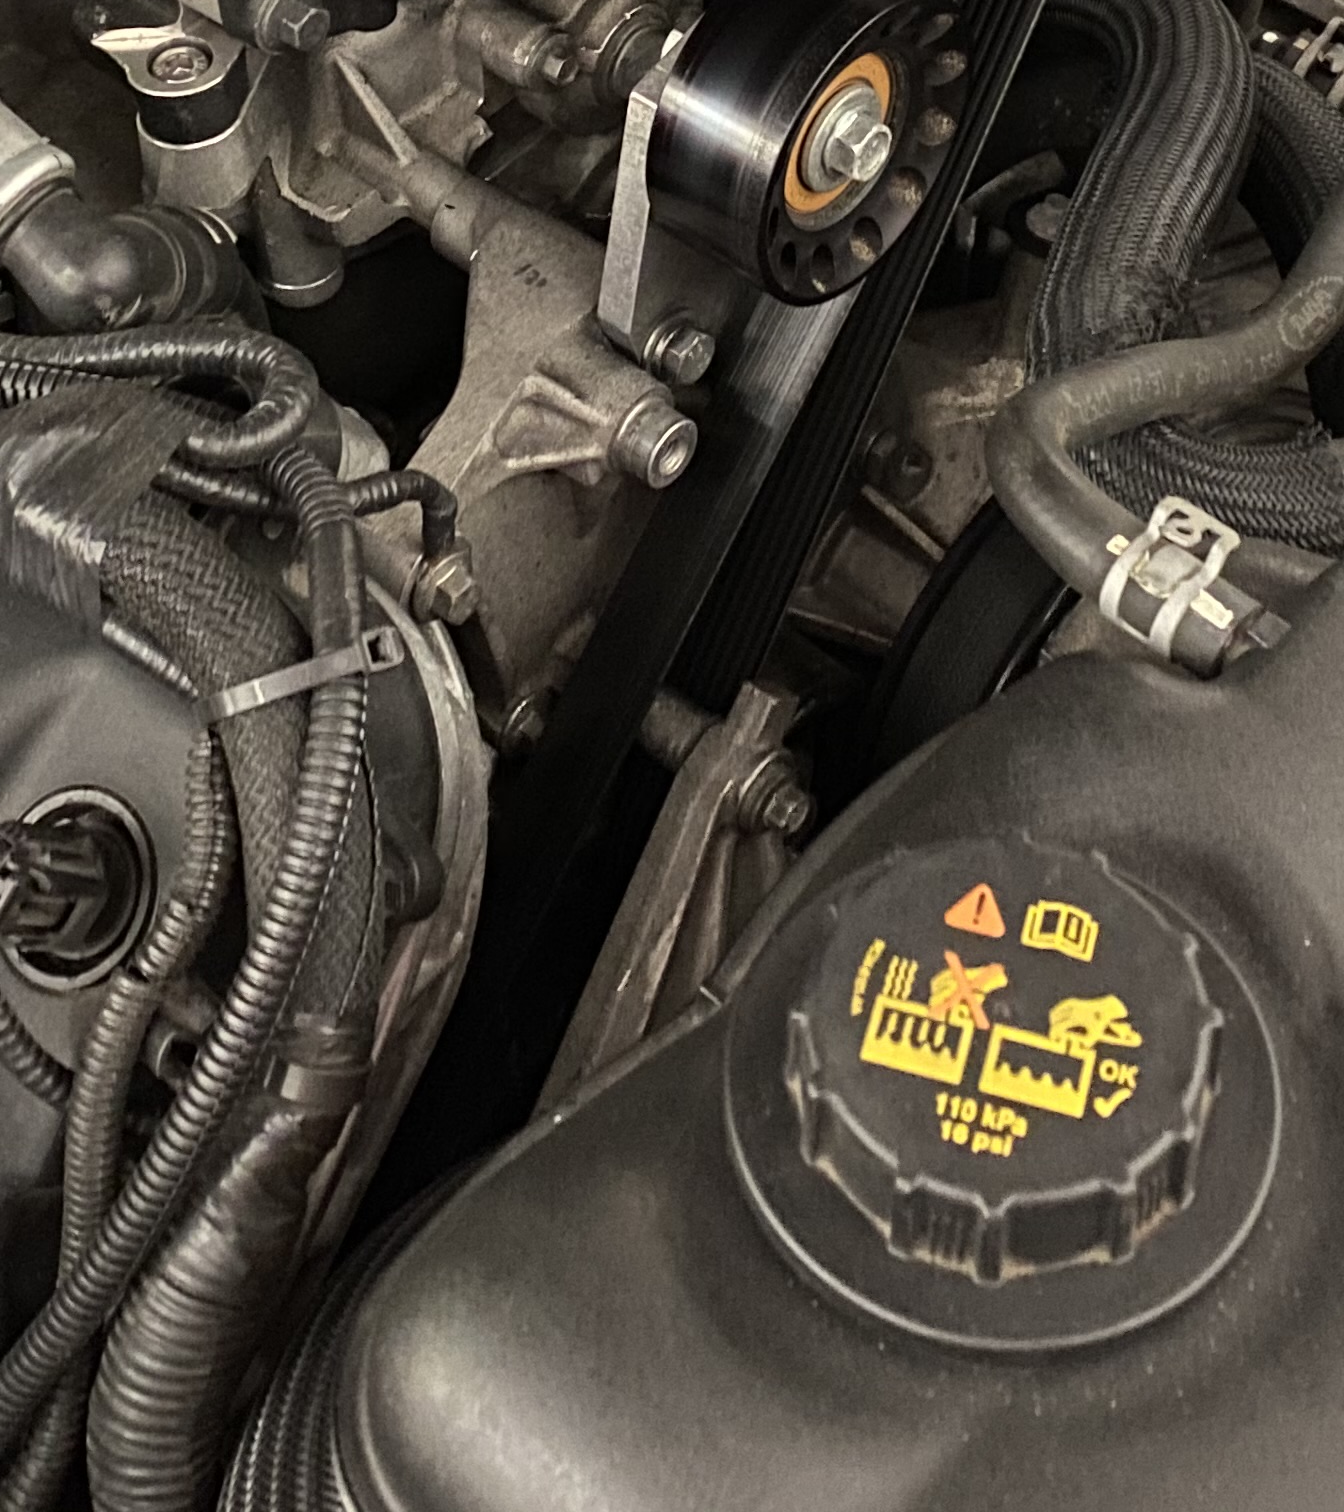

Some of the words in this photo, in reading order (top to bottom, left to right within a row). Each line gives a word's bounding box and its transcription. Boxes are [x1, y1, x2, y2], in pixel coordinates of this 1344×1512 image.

[1098, 1058, 1140, 1089] OK
[935, 1091, 978, 1123] 110
[981, 1102, 1029, 1138] kPa
